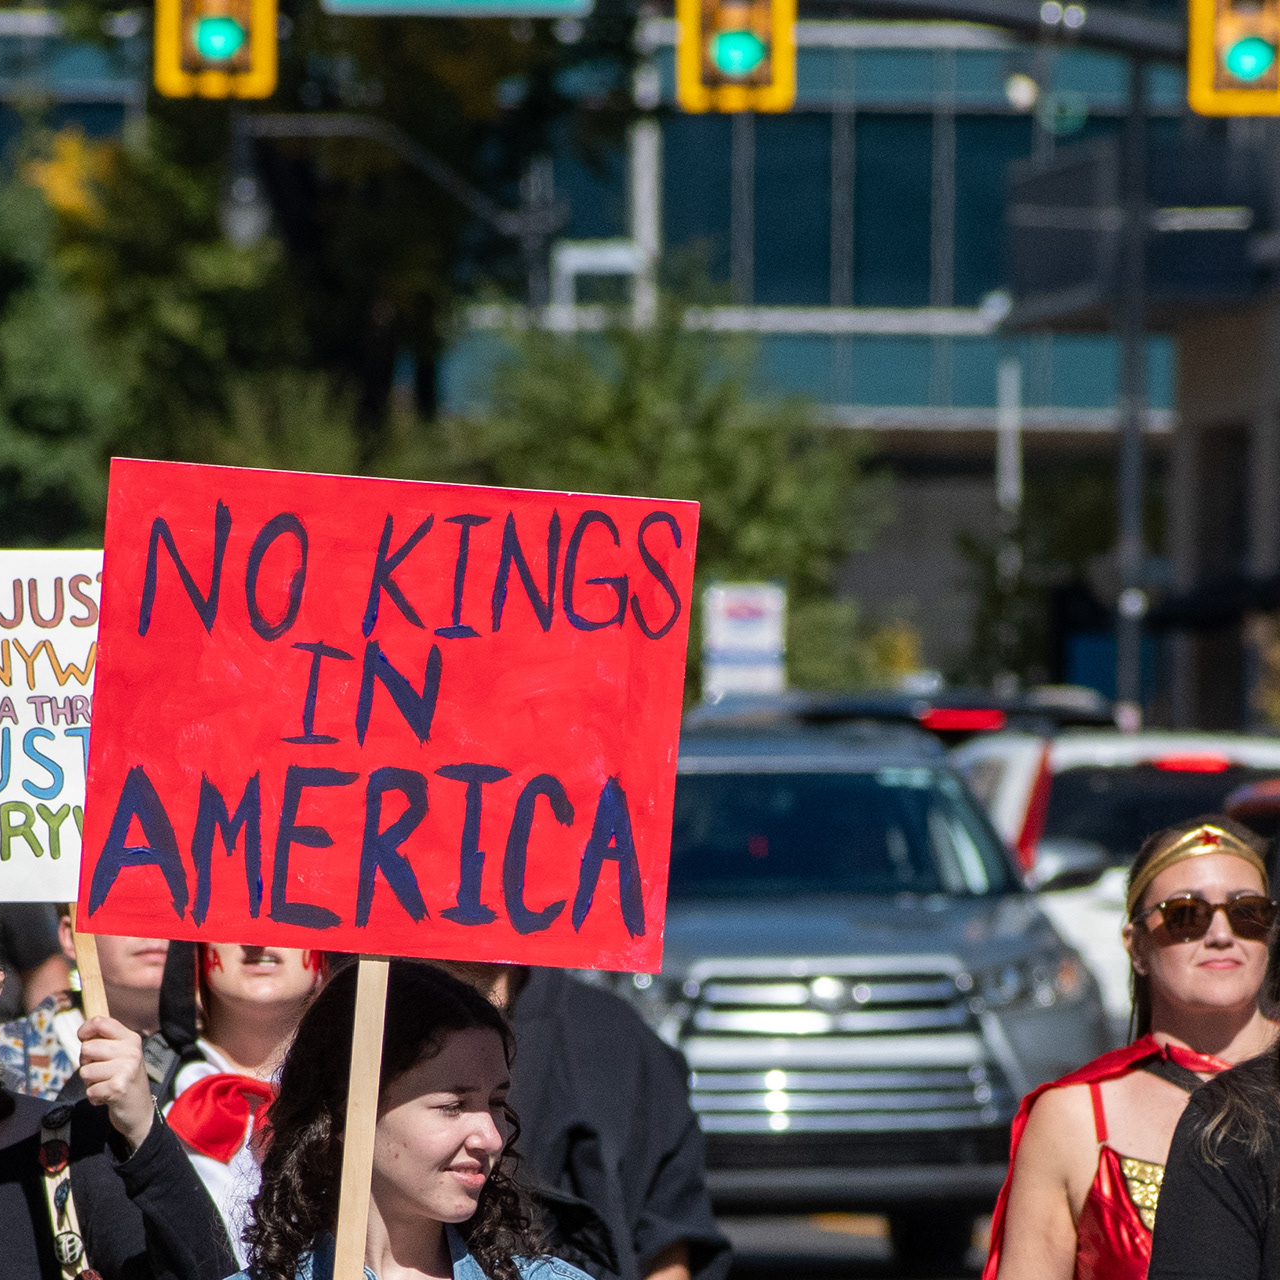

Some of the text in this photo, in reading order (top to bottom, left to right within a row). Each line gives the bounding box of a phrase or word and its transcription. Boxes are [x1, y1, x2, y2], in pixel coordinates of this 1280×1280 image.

[137, 499, 309, 641] NO
[361, 508, 683, 640] KINGS
[280, 639, 443, 748] IN
[87, 762, 646, 939] AMERICA
